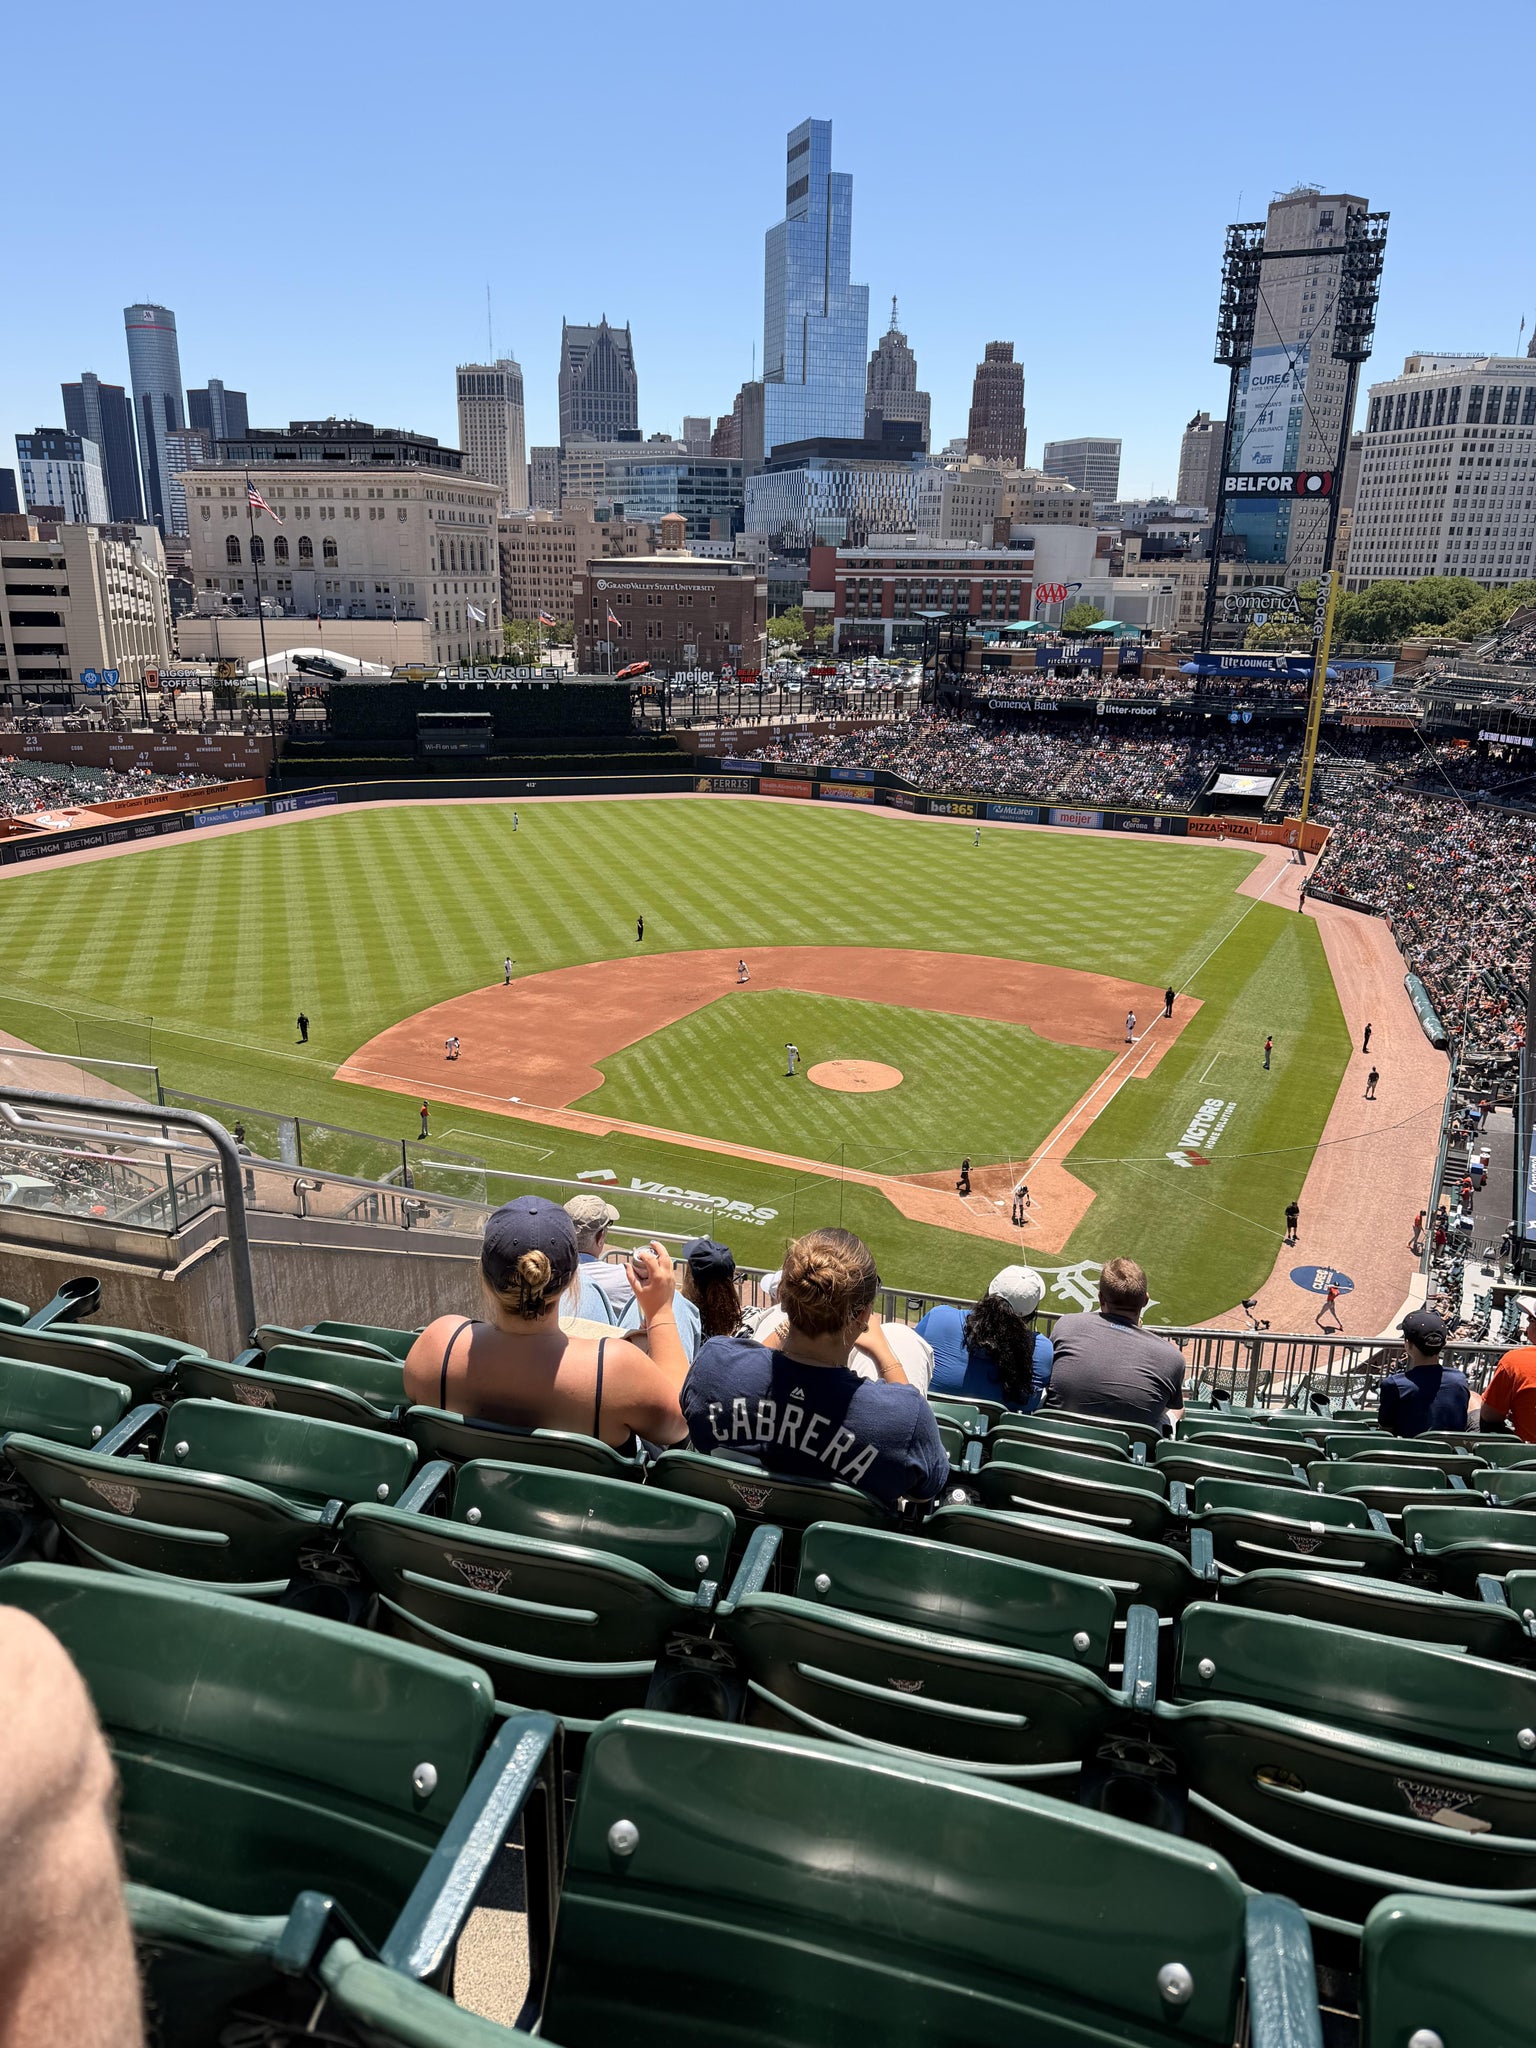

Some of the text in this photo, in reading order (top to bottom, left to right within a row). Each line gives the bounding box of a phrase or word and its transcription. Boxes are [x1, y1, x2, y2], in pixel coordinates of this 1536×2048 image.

[1258, 410, 1274, 425] #1
[1225, 476, 1294, 492] BELFOR
[607, 581, 631, 590] GRAND
[631, 582, 655, 590] VALLEY
[1037, 584, 1067, 602] AAA
[1222, 613, 1300, 624] LANDING
[1312, 587, 1331, 641] Rocket
[1062, 644, 1080, 659] Lite
[1220, 656, 1273, 669] Lite LOUNGE
[159, 669, 198, 678] BIGGBY
[445, 666, 566, 680] CHEVROLET
[675, 667, 714, 684] meijer
[161, 680, 198, 689] COFFEE
[819, 675, 837, 683] LAW
[1034, 701, 1059, 711] Bank
[773, 727, 781, 735] 10
[801, 724, 808, 732] 11
[827, 722, 837, 730] 42
[25, 736, 38, 745] 23
[117, 735, 124, 744] 5
[161, 736, 168, 745] 2
[203, 736, 213, 745] 16
[248, 738, 255, 747] 6
[138, 752, 149, 760] 47
[184, 752, 191, 761] 3
[713, 778, 749, 789] FERRIS
[275, 799, 298, 813] DTE
[930, 801, 974, 816] bet365
[1003, 806, 1034, 816] McLaren
[1060, 812, 1092, 825] meijer
[1122, 820, 1149, 830] Corona
[69, 835, 102, 850] BETMGM
[25, 843, 61, 857] BETMGM
[1177, 1098, 1225, 1147] VICTORS
[1203, 1102, 1238, 1150] HOME SOLUTIONS
[671, 1201, 767, 1226] SOLUTIONS
[708, 1397, 880, 1485] CABRERA
